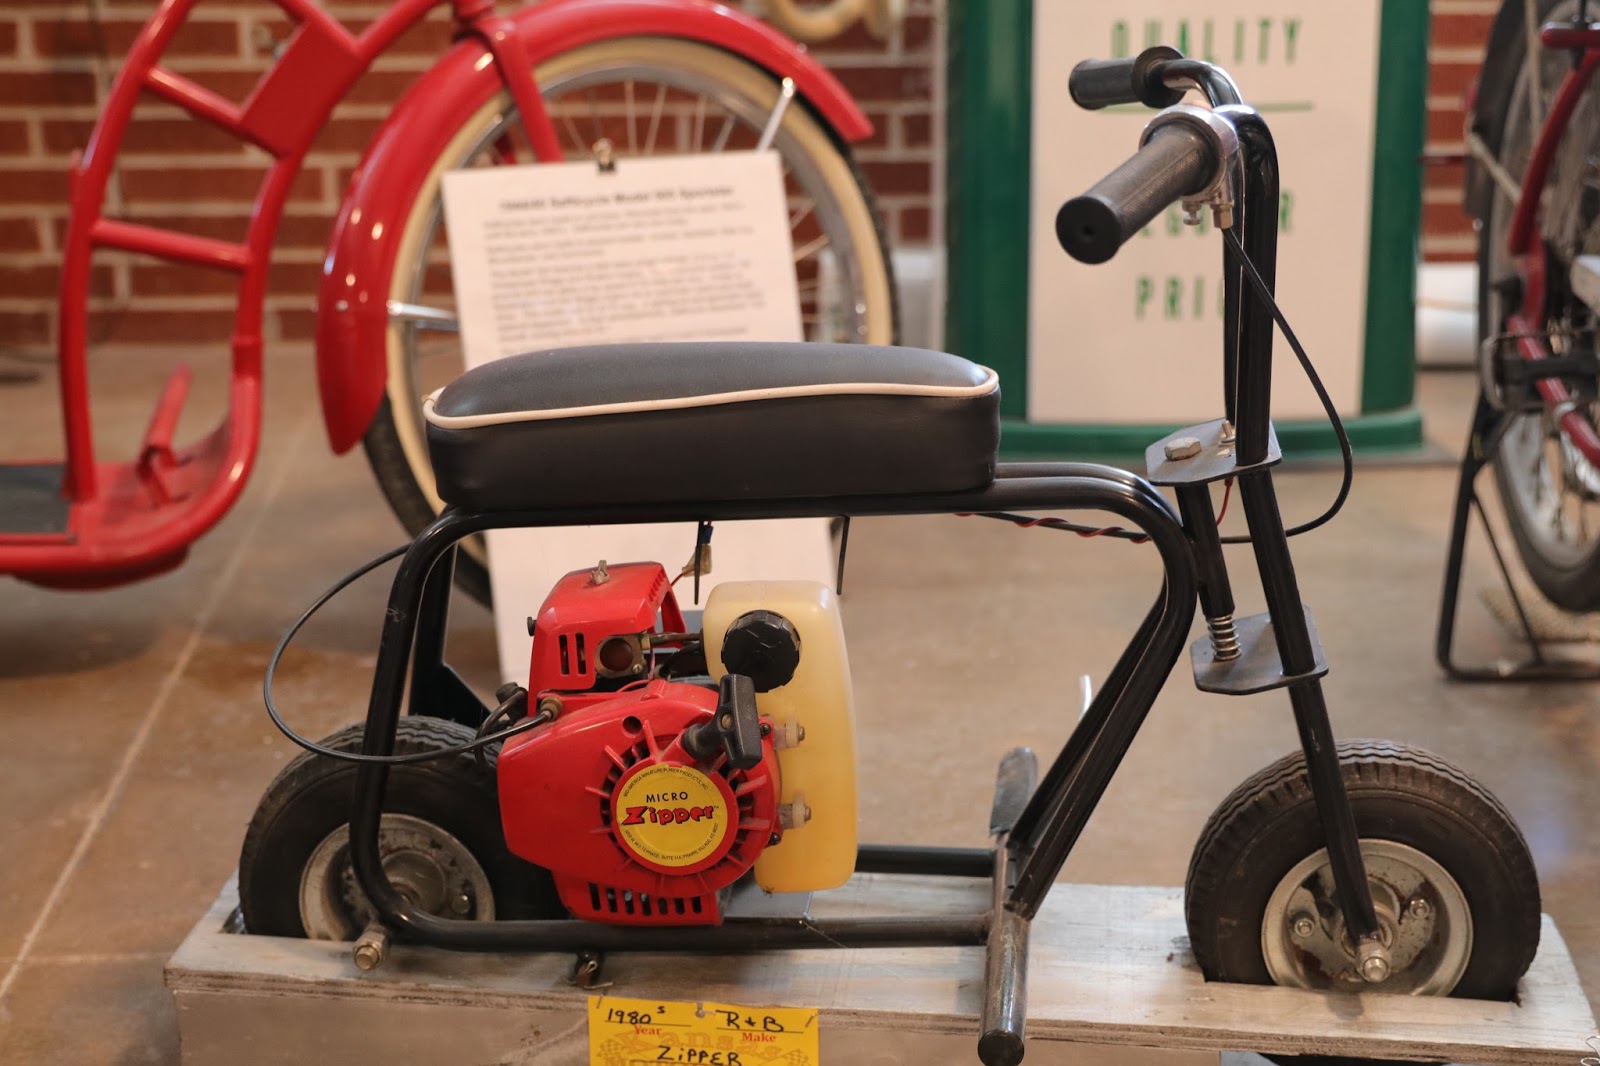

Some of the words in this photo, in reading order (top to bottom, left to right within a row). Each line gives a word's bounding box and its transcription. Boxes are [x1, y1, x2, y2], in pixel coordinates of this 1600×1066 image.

[1112, 18, 1301, 65] QUALITY
[1136, 275, 1224, 319] PRI
[646, 791, 689, 803] MICRO
[633, 1025, 662, 1036] Year
[741, 1032, 777, 1043] Make
